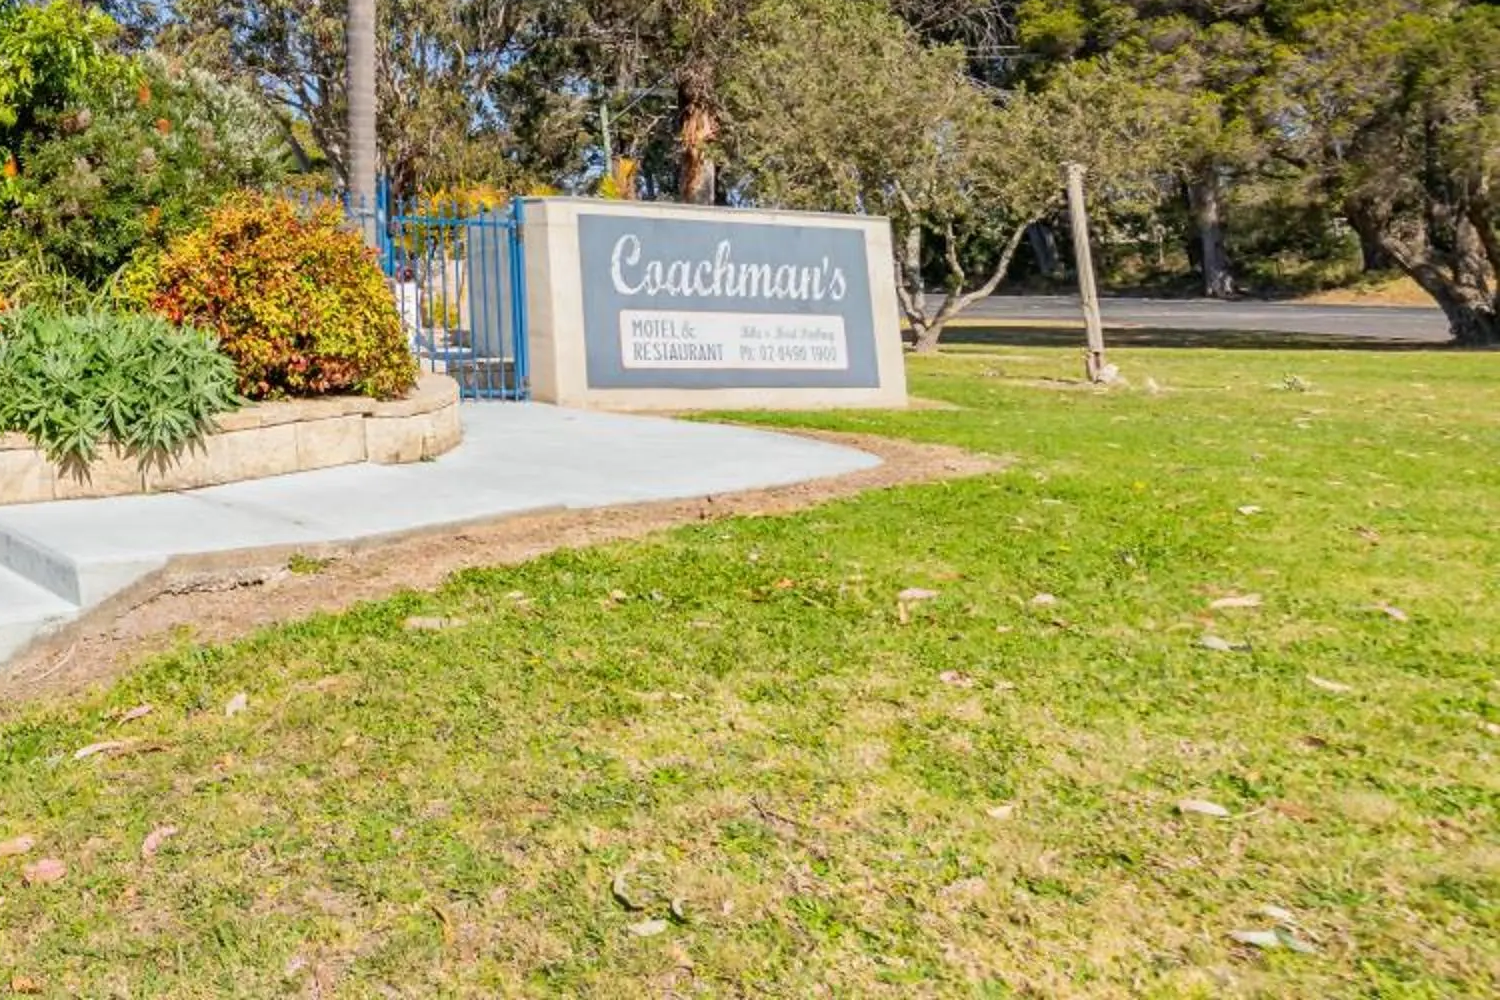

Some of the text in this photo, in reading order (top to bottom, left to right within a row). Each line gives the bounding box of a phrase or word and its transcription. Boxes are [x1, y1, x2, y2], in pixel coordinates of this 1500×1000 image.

[611, 234, 847, 301] Coachman's
[632, 319, 698, 340] MOTEL &
[633, 343, 724, 361] RESTAURANT
